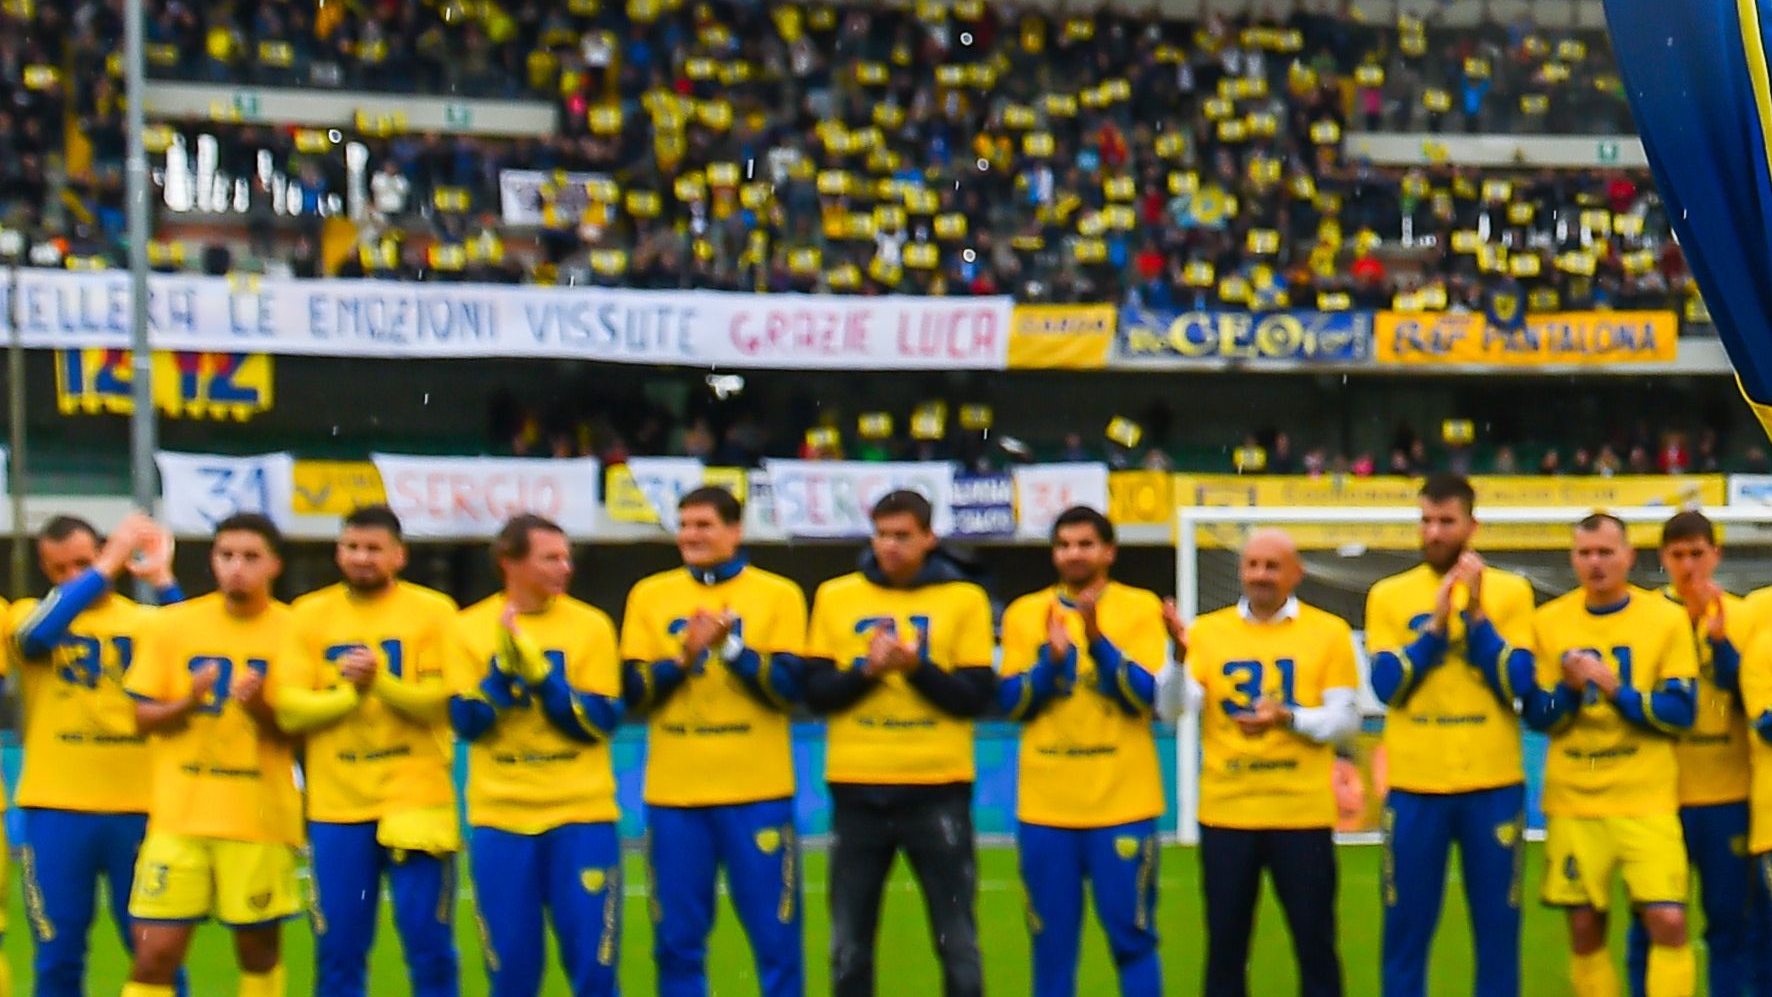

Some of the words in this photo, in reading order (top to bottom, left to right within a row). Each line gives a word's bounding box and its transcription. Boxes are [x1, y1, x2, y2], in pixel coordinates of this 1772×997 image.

[523, 306, 700, 356] VISSUTE
[729, 307, 873, 355] GRAZIE
[897, 308, 998, 357] LUCA
[396, 471, 562, 522] SERGIO
[1222, 658, 1301, 716] 31
